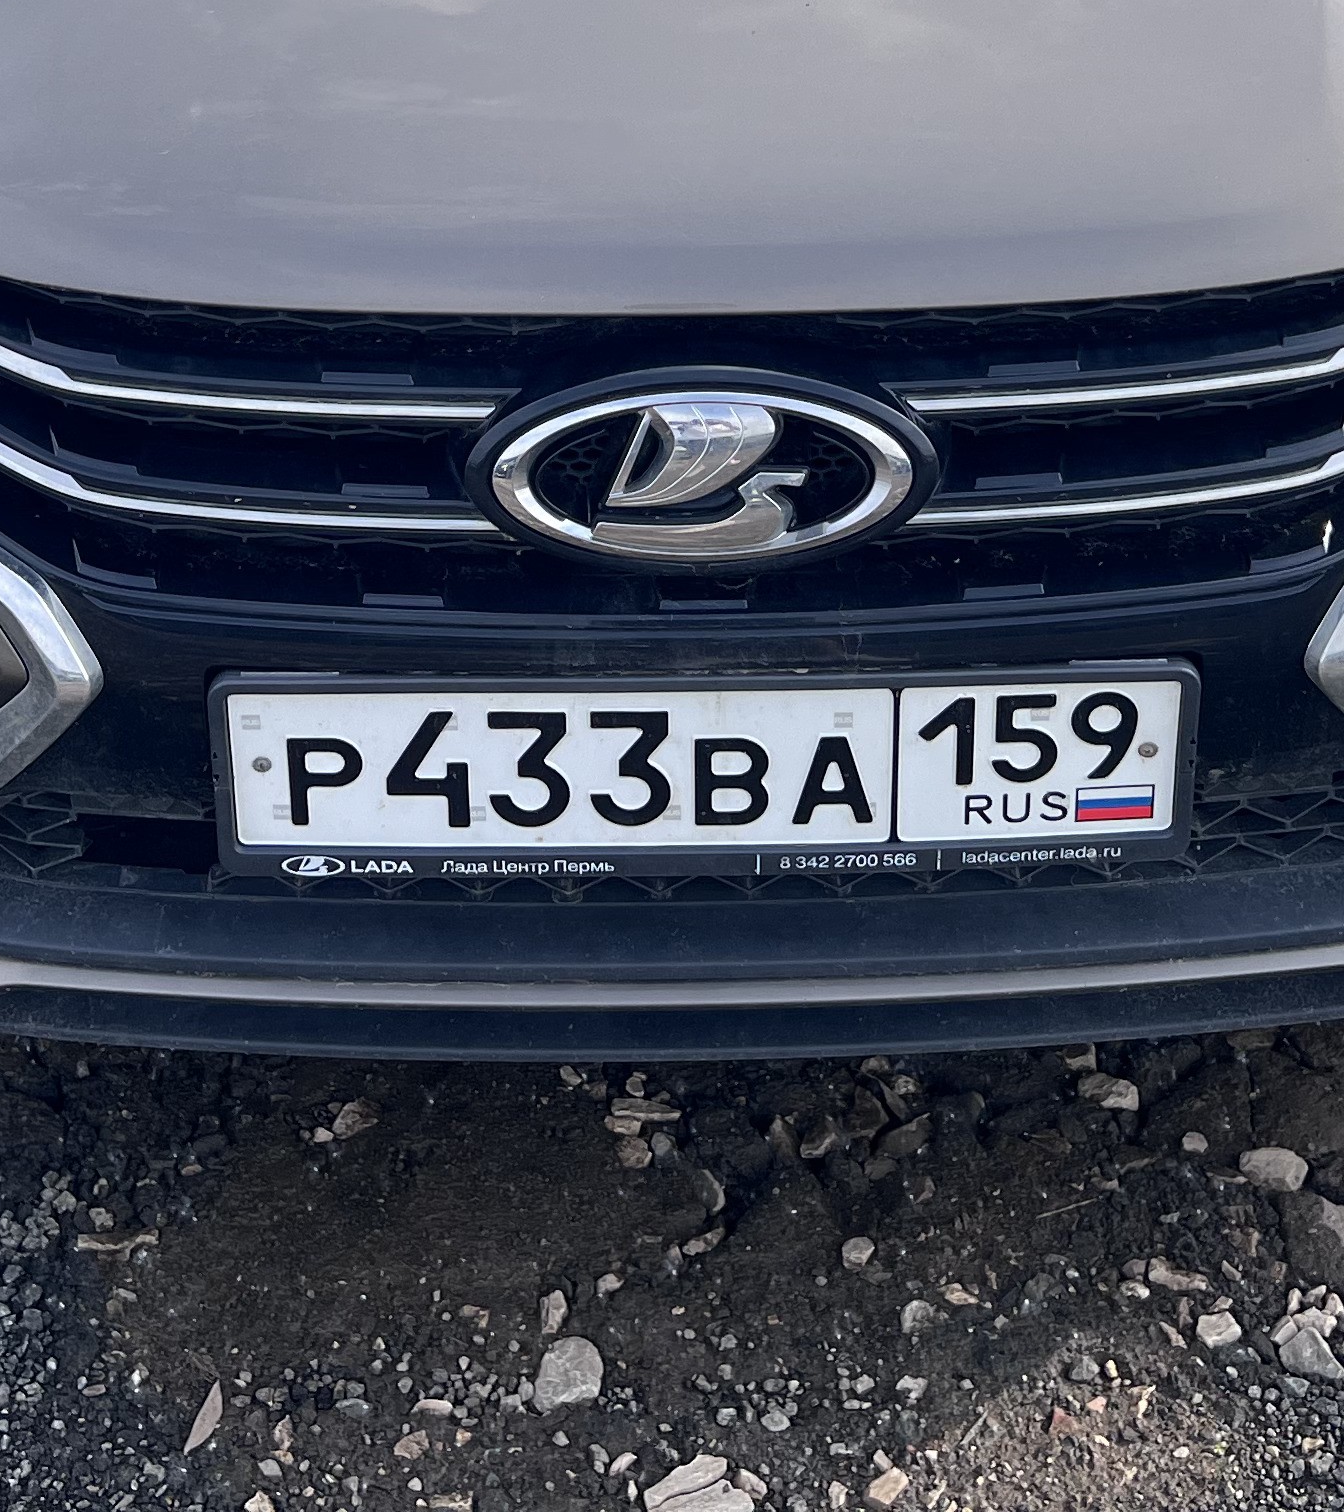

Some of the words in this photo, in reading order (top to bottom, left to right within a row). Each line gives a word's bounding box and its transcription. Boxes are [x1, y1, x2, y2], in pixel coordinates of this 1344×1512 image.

[286, 710, 874, 828] Р433ВА
[918, 692, 1140, 786] 159
[964, 790, 1069, 826] RUS
[780, 856, 790, 869] 8
[795, 855, 831, 869] 342
[834, 854, 879, 868] 2700
[883, 853, 917, 867] 566
[962, 844, 1123, 864] ladacenter.lada.ru
[350, 860, 414, 874] LADA
[441, 859, 489, 874] Лада
[493, 860, 550, 876] Центр
[554, 860, 615, 876] Пермь
